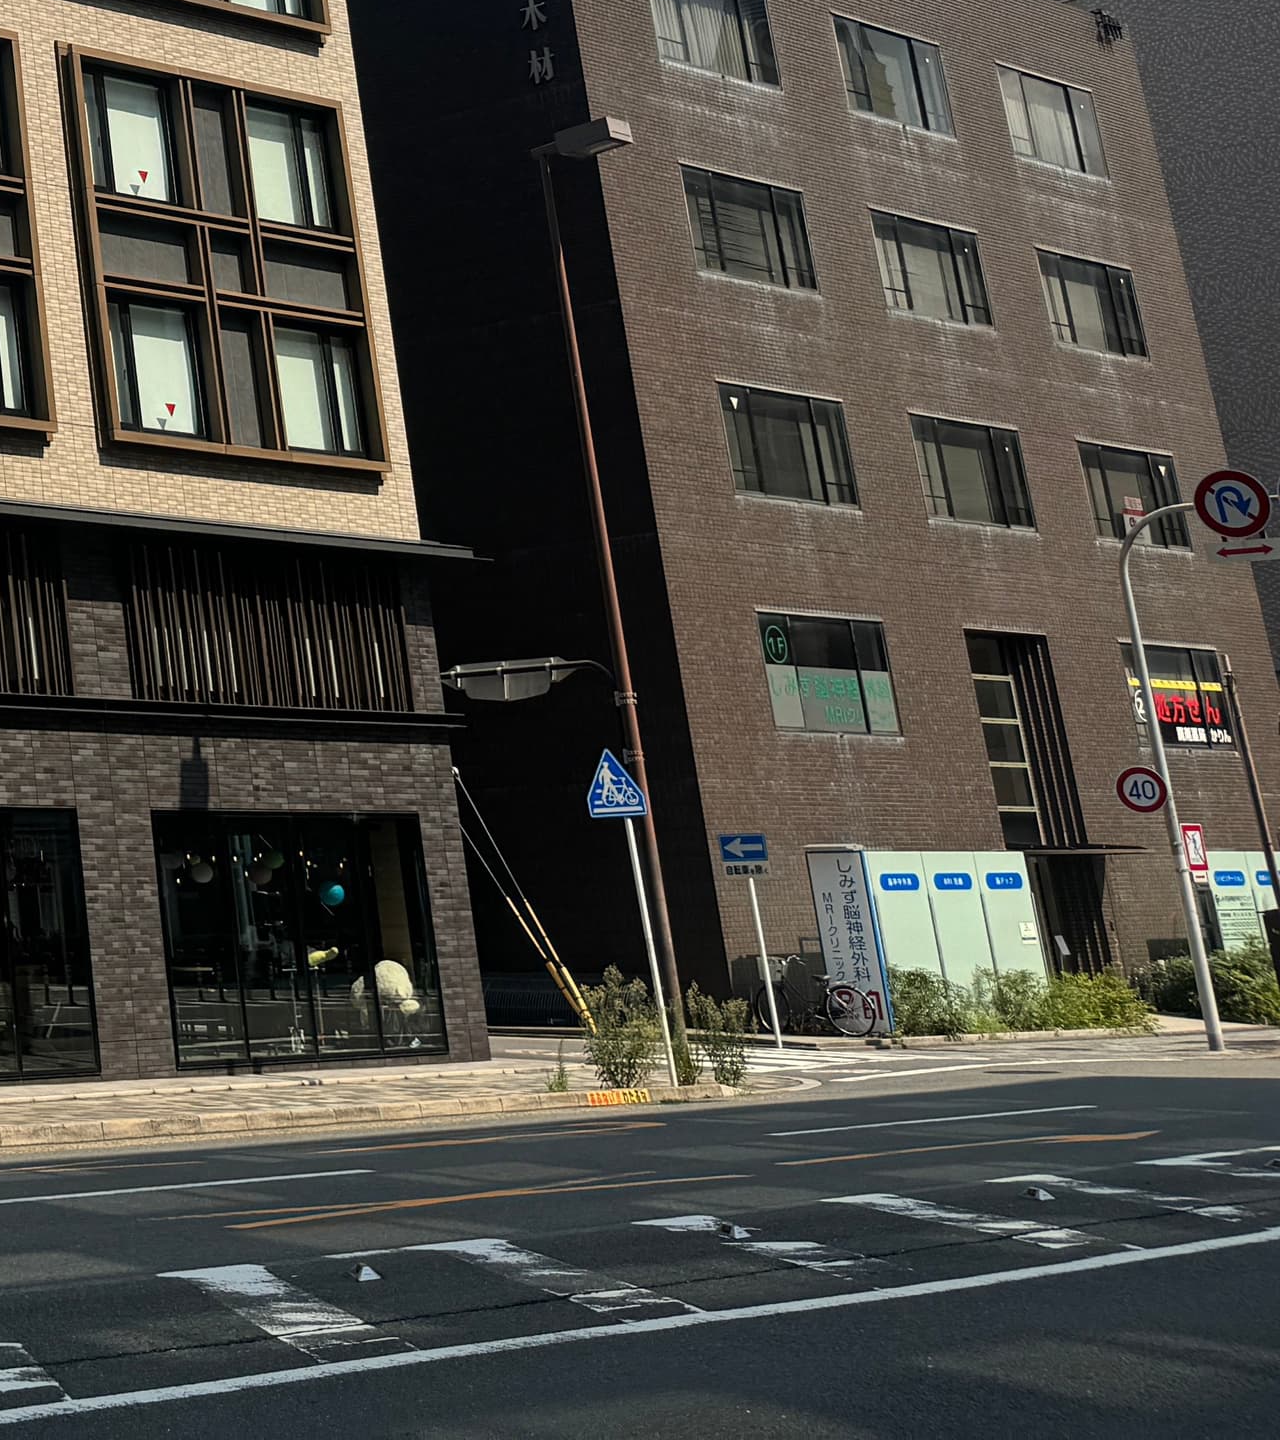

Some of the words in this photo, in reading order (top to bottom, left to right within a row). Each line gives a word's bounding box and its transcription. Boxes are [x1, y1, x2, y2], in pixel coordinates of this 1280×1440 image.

[1129, 779, 1157, 801] 40
[836, 858, 872, 983] しみず脳神経外科
